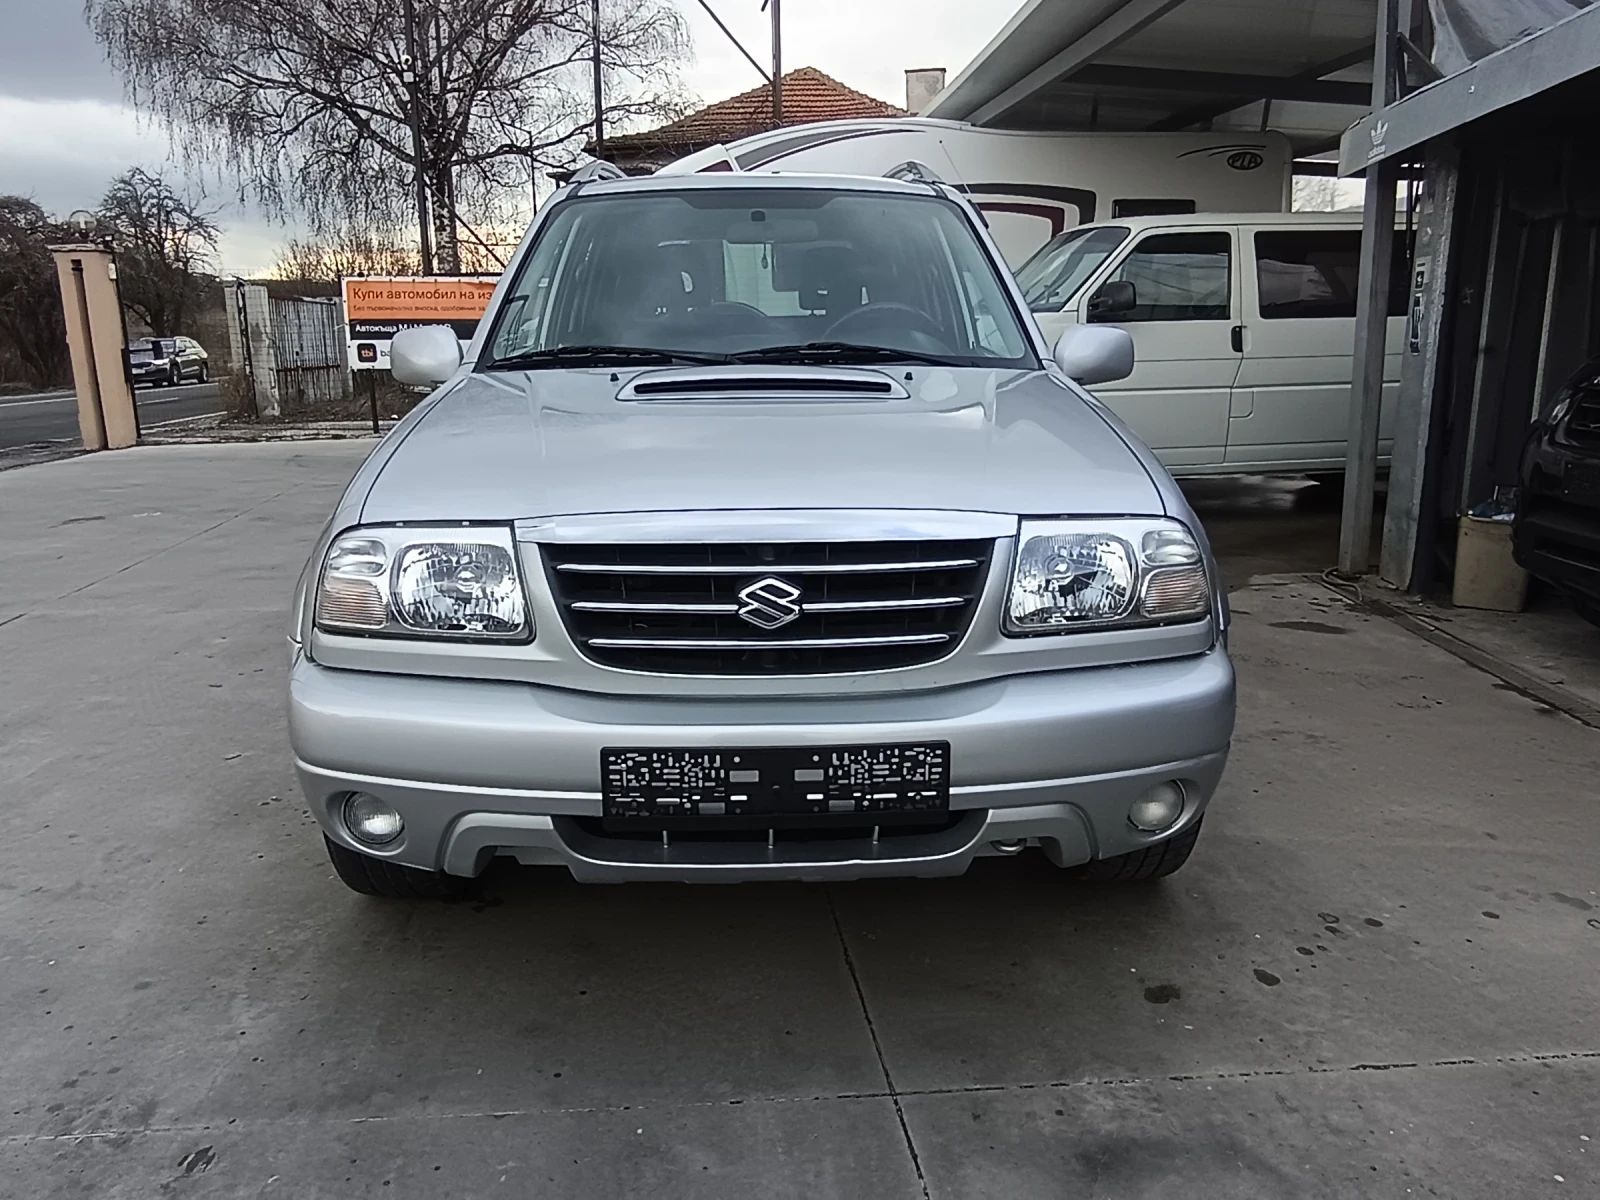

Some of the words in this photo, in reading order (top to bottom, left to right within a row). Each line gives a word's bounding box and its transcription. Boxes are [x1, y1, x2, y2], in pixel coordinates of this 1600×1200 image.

[353, 288, 383, 301] Купи
[386, 288, 456, 300] автомобил
[459, 290, 475, 300] на
[355, 324, 397, 333] Автокъща
[361, 348, 374, 358] tbi
